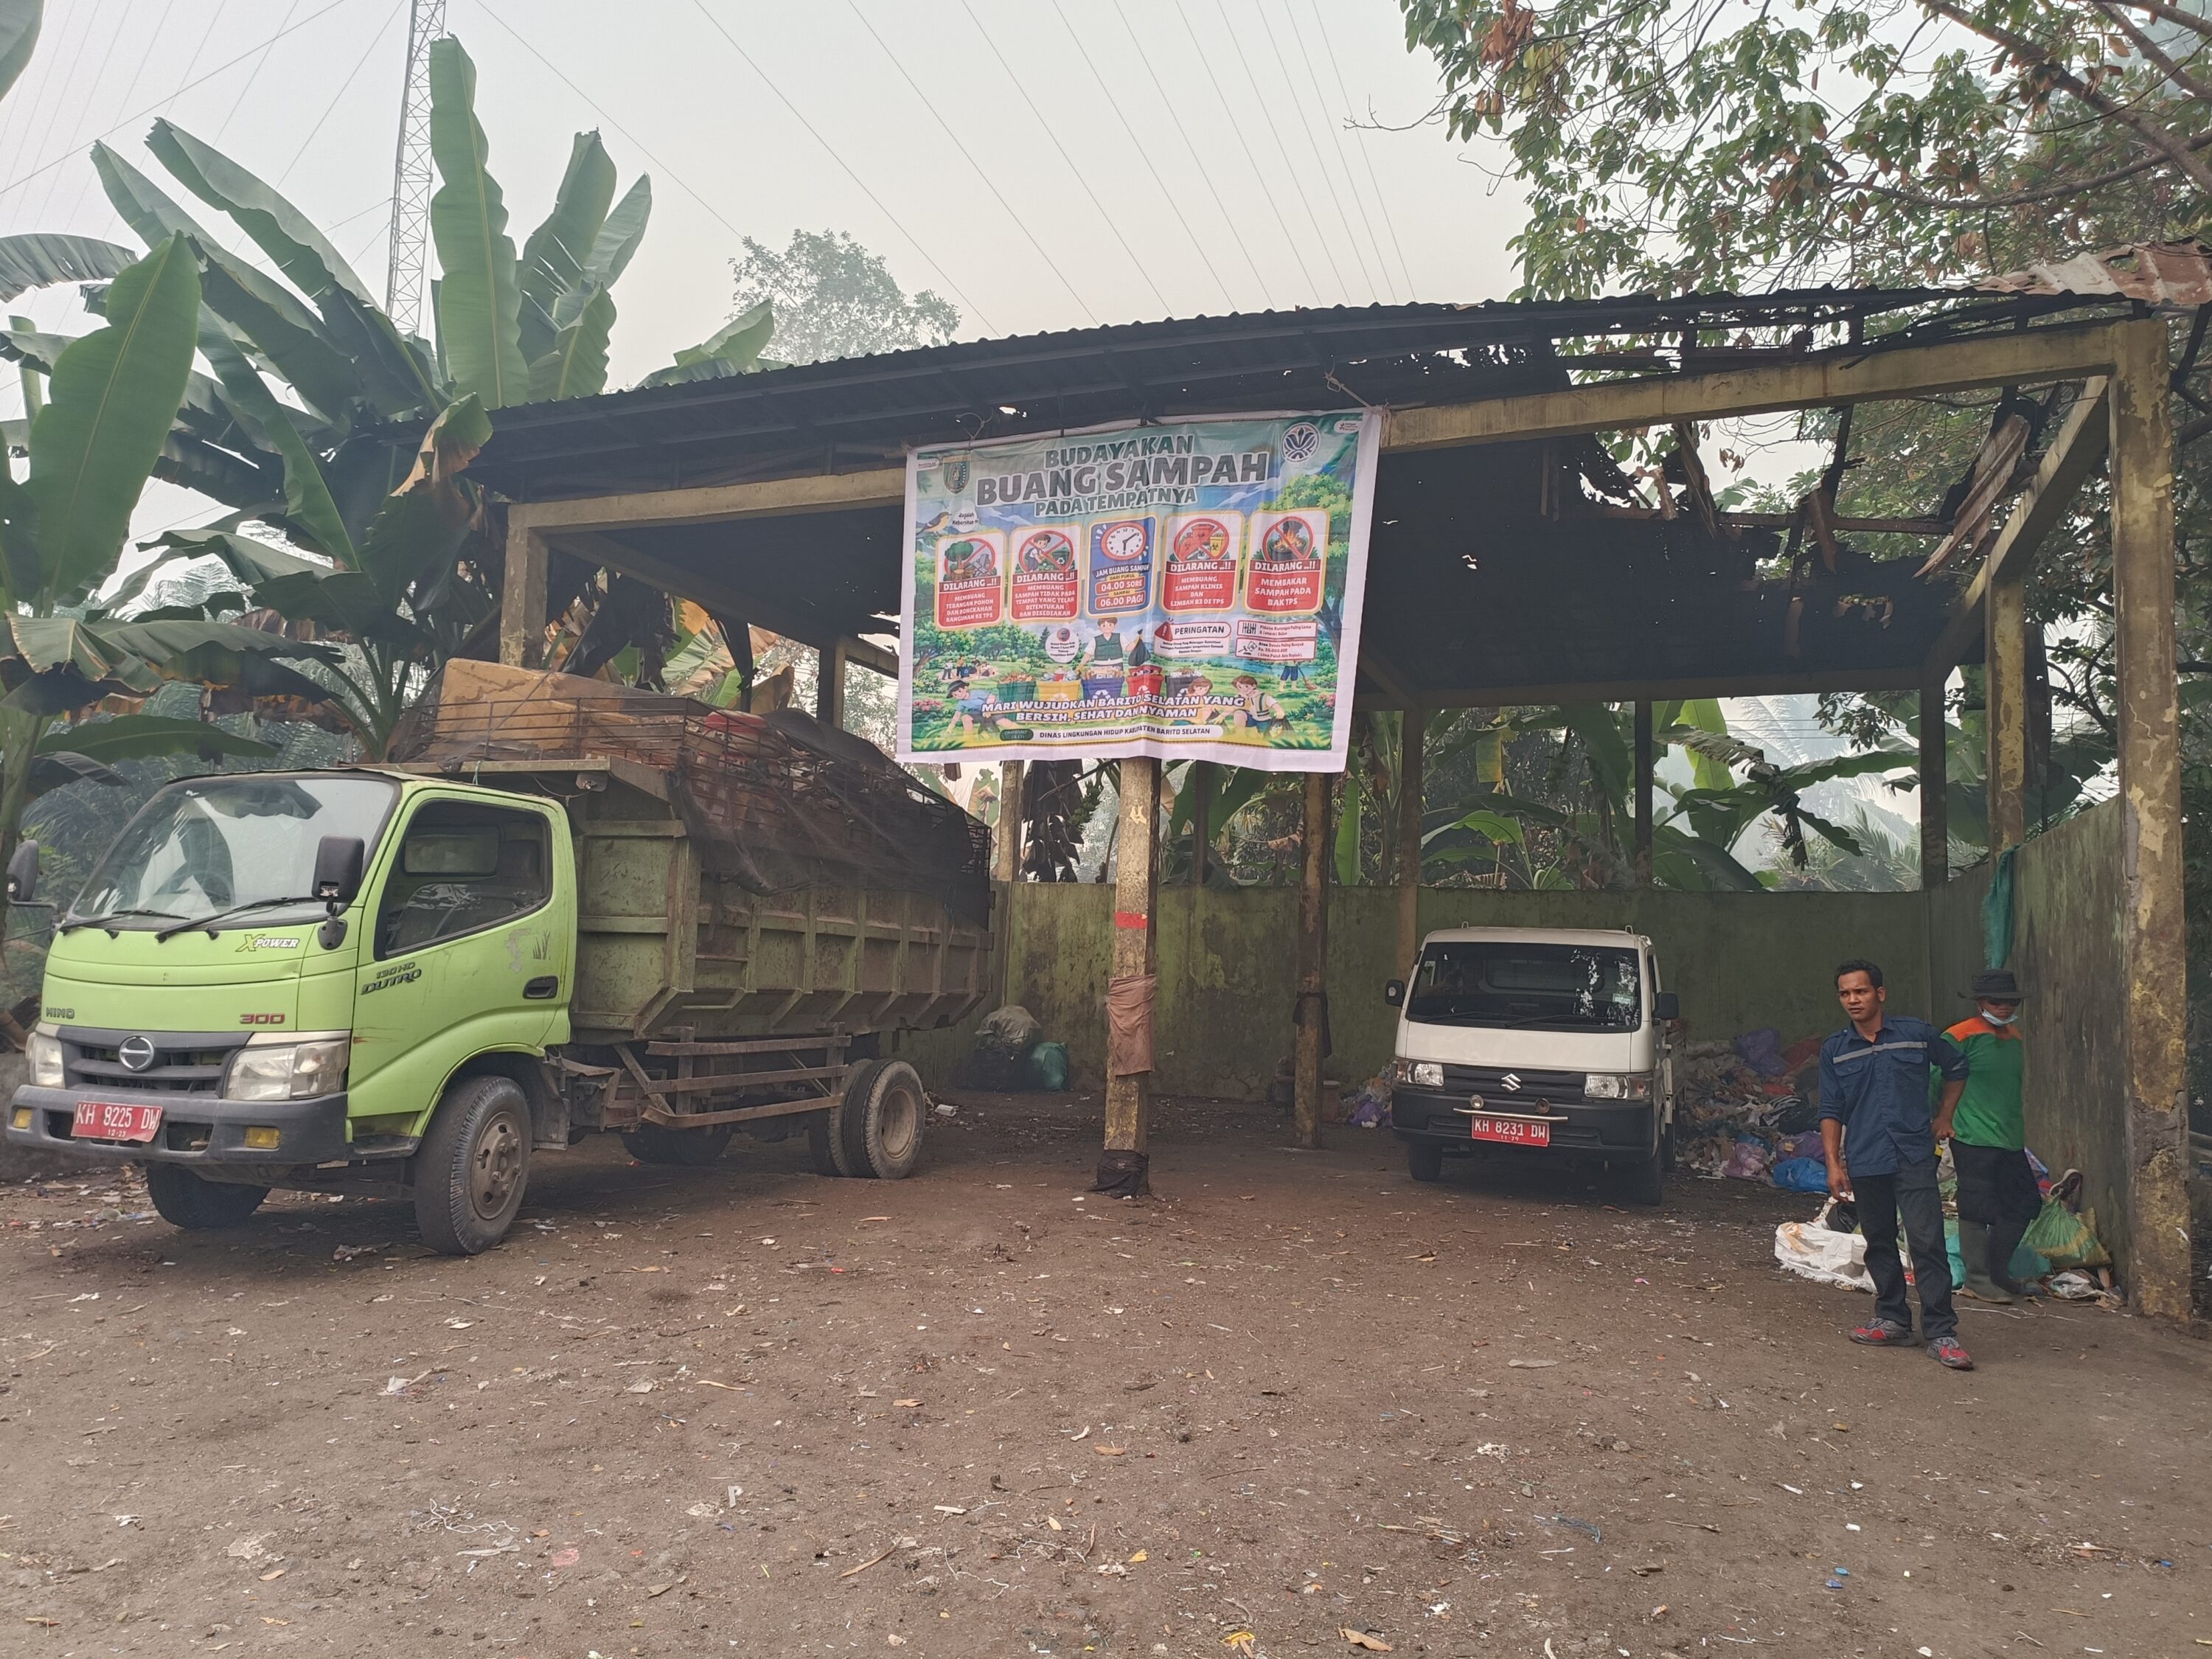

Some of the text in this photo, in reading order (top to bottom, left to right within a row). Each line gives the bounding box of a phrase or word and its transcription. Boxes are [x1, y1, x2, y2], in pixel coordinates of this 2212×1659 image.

[1046, 435, 1194, 467] BUDAYAKAN
[978, 453, 1267, 505] BUANG SAMPAH
[1036, 488, 1196, 515] PADA TEMPATNYA
[1096, 568, 1108, 577] JAM
[1109, 566, 1129, 574] BUANG
[1170, 562, 1217, 572] DILARANG
[1255, 561, 1302, 572] DILARANG
[1018, 573, 1064, 582] DILARANG
[1261, 577, 1307, 586] MEMBAKAR
[944, 580, 985, 591] DILARANG
[1101, 580, 1143, 591] 04.00 SORE
[955, 593, 986, 601] MEMBUANG
[1255, 587, 1311, 597] SAMPAH PADA
[946, 601, 973, 609] TEBANGAN
[1100, 594, 1144, 607] 06.00 PAGI
[1267, 598, 1284, 606] BAK
[959, 606, 992, 614] BONGKAHAN
[1175, 626, 1224, 635] PERINGATAN
[981, 693, 1245, 712] MARI WUJUDKAN BARITO SELATAN YANG
[1016, 706, 1197, 722] BERSIH, SEHAT DAN NYAMAN
[1062, 730, 1103, 738] LINGKUNGAN
[1124, 726, 1155, 734] KABUPATEN
[376, 961, 416, 979] 130 HD
[361, 968, 422, 995] DUTRO
[46, 1007, 75, 1019] HINO
[239, 1013, 285, 1025] 300
[75, 1103, 160, 1130] KH 8225 DW
[1475, 1119, 1545, 1138] KH 8231 DW
